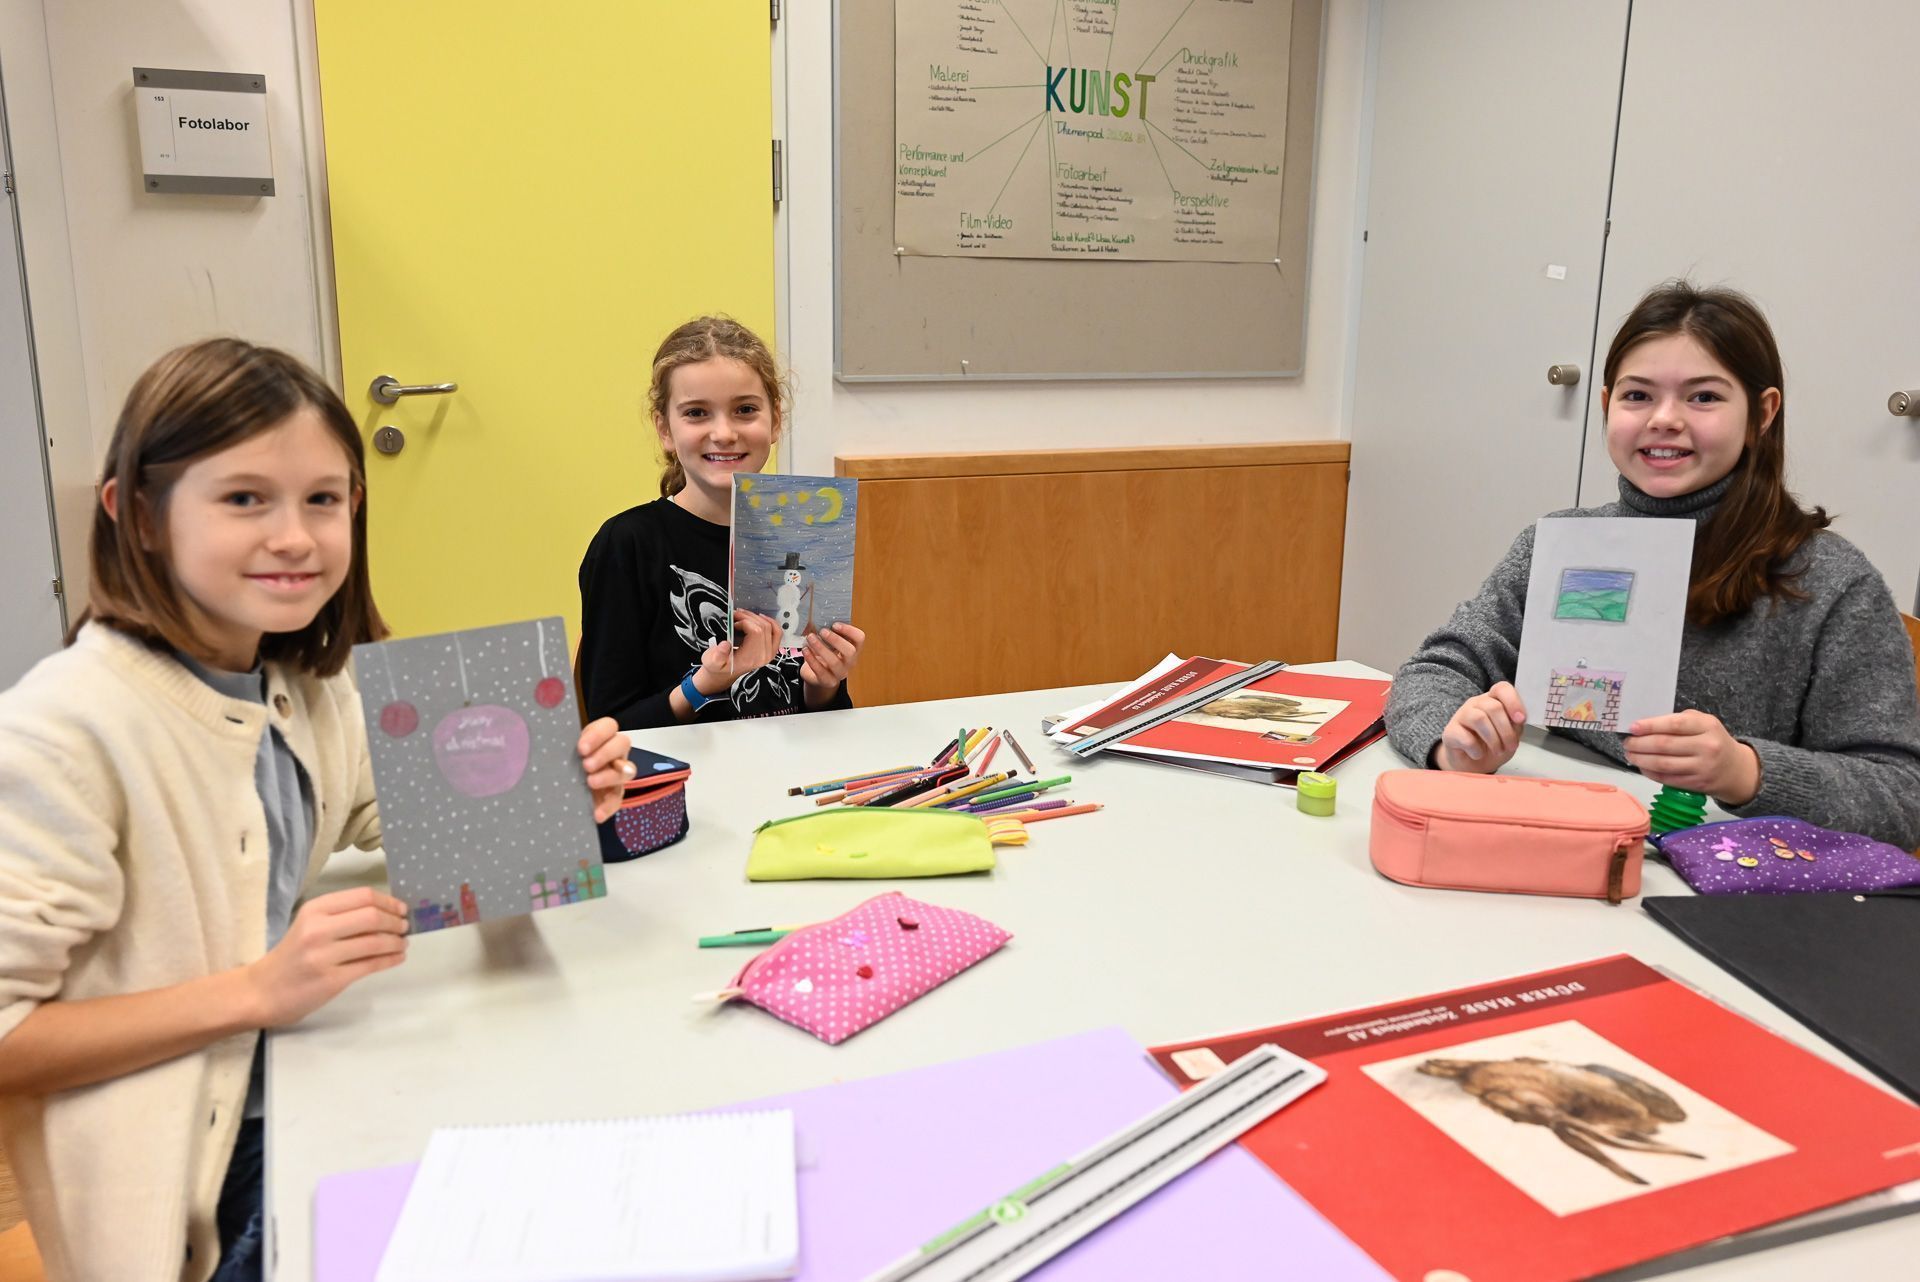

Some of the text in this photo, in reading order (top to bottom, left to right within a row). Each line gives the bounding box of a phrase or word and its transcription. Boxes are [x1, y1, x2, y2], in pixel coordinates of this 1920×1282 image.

[1182, 47, 1239, 73] Druckgrafik
[929, 63, 970, 82] Malerei
[1045, 65, 1156, 120] KUNST
[178, 116, 250, 131] Fotolabor
[899, 143, 964, 163] Performance und
[1057, 161, 1107, 182] Fotoarbeit
[1173, 190, 1230, 212] Perspektive
